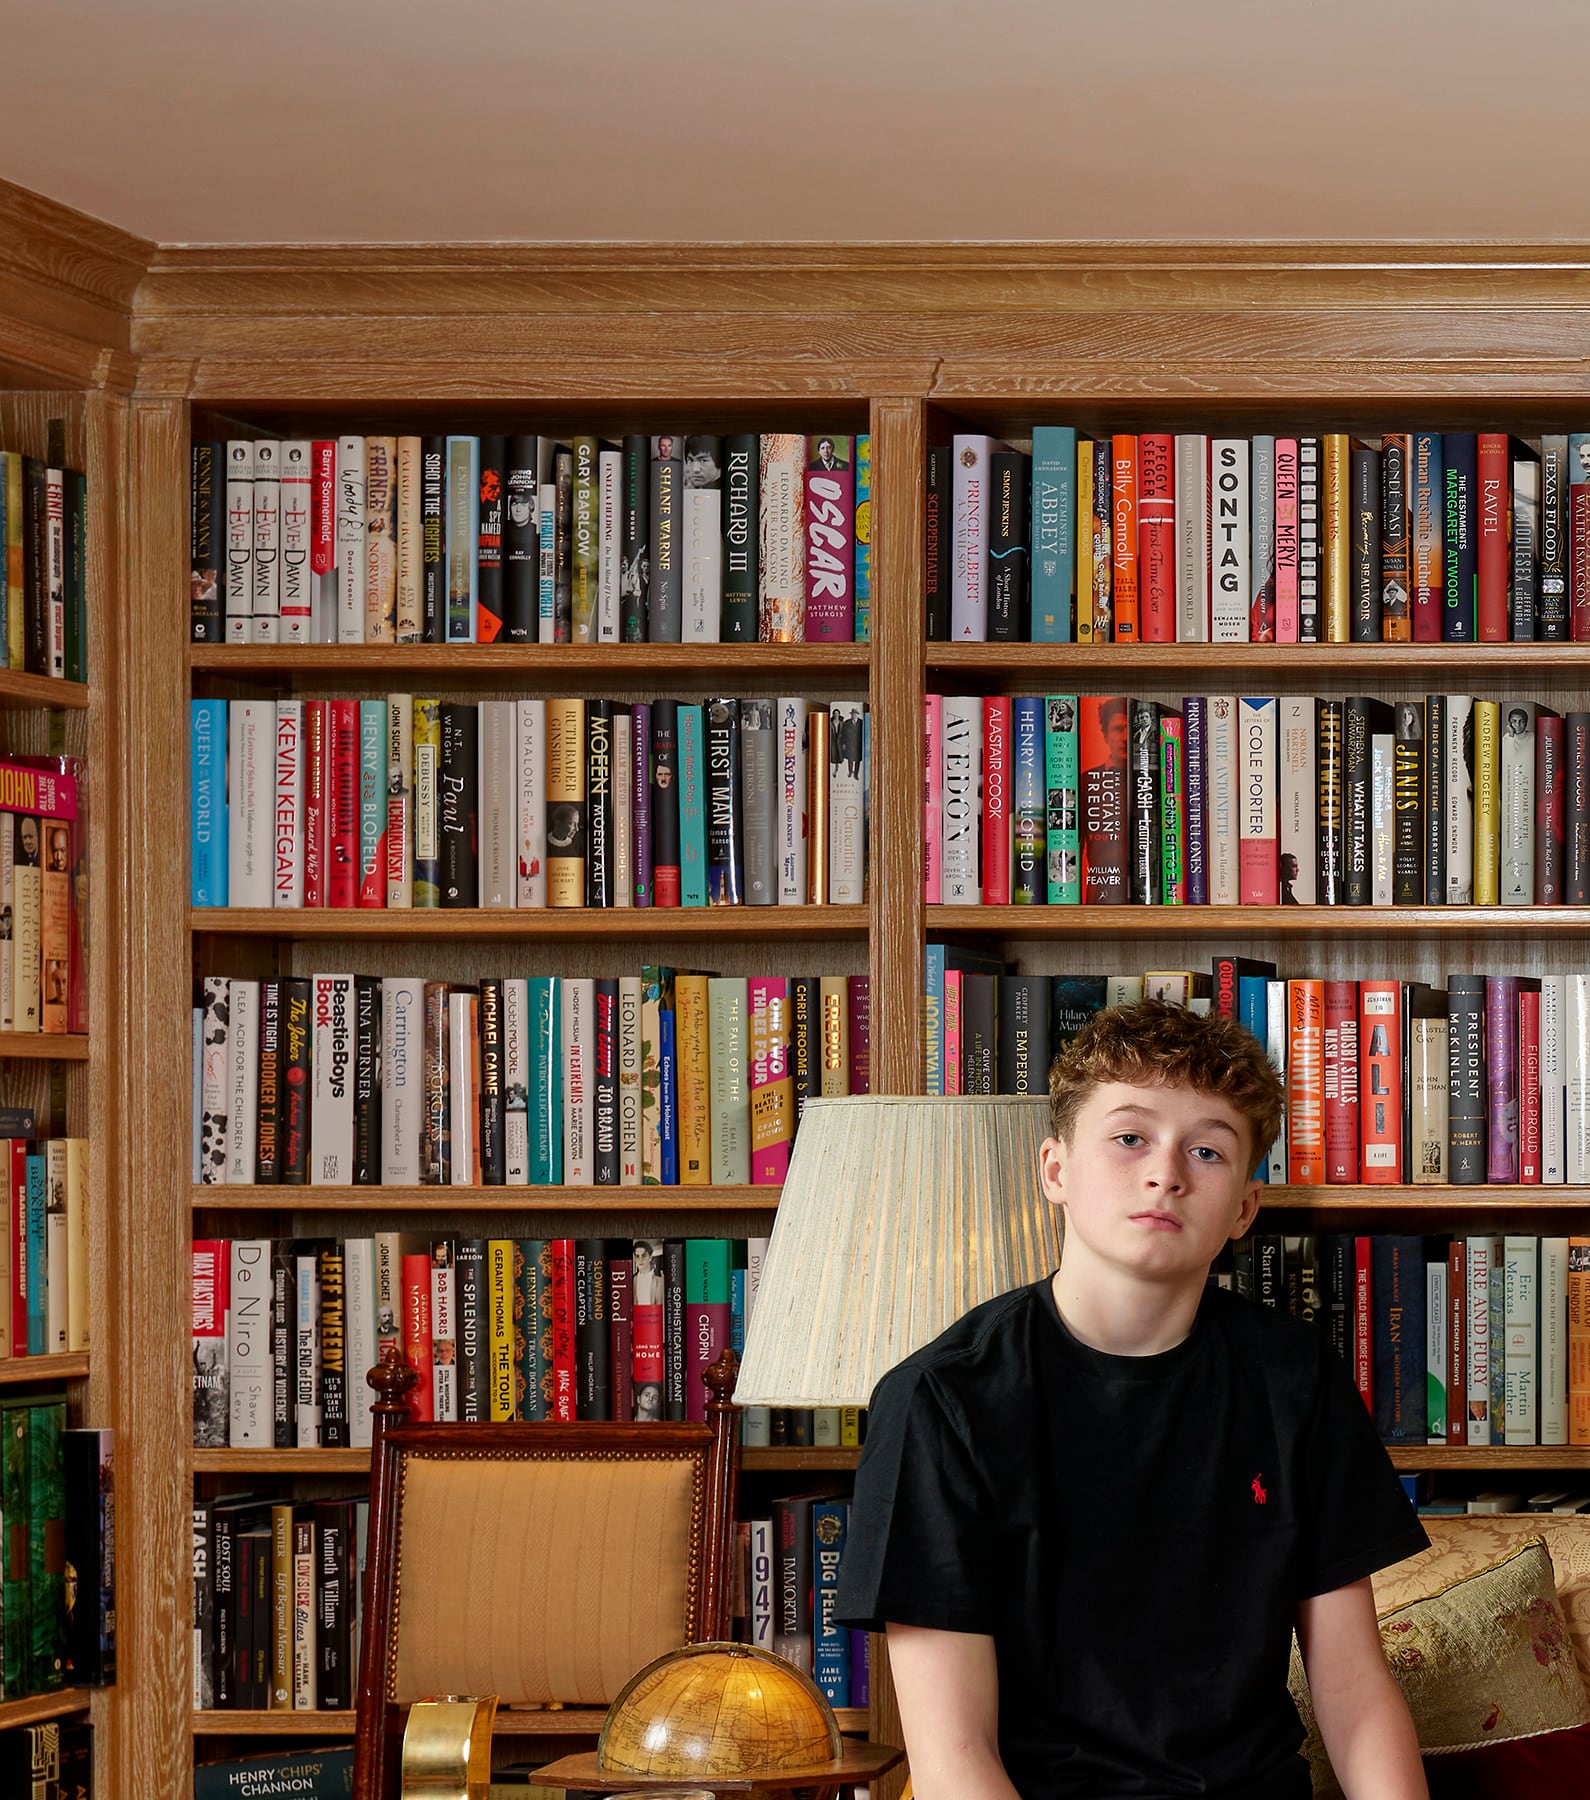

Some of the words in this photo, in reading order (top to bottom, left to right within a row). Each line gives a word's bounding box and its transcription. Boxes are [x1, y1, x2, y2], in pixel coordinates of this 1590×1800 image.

[578, 445, 590, 485] GARY
[1116, 460, 1131, 495] Billy
[578, 488, 589, 556] BARLOW
[728, 451, 748, 546] RICHARD
[1042, 482, 1058, 555] ABBEY
[1219, 448, 1238, 593] SONTAG
[1447, 468, 1457, 544] MARGARET
[1484, 480, 1499, 537] RAVEL
[730, 550, 746, 571] III
[808, 477, 846, 599] OSCAR
[1115, 499, 1131, 571] Connolly
[1447, 550, 1457, 607] ATWOOD
[279, 718, 296, 786] KEVIN
[590, 716, 609, 794] MOEEN
[946, 712, 970, 843] AVEDON
[1396, 744, 1417, 811] JANIS
[443, 773, 464, 832] Paul
[277, 793, 293, 891] KEEGAN
[316, 979, 333, 1028] Book
[360, 987, 372, 1027] TINA
[622, 993, 634, 1068] LEONARD
[359, 1027, 370, 1100] TURNER
[392, 989, 412, 1088] Carrington
[1292, 1027, 1320, 1094] FUNNY
[1468, 1013, 1478, 1099] PRESIDENT
[624, 1096, 635, 1153] COHEN
[1292, 1099, 1320, 1145] MAN
[193, 1252, 215, 1279] MAX
[237, 1247, 261, 1282] De
[1474, 1249, 1488, 1294] FIRE
[193, 1281, 215, 1330] HASTINGS
[612, 1271, 626, 1322] Blood
[1474, 1298, 1488, 1337] AND
[236, 1296, 260, 1357] Niro
[699, 1314, 710, 1361] CHOPIN
[1474, 1343, 1488, 1387] FURY
[755, 1526, 771, 1641] 1947
[229, 1768, 275, 1785] HENRY
[241, 1777, 313, 1796] CHANNON
